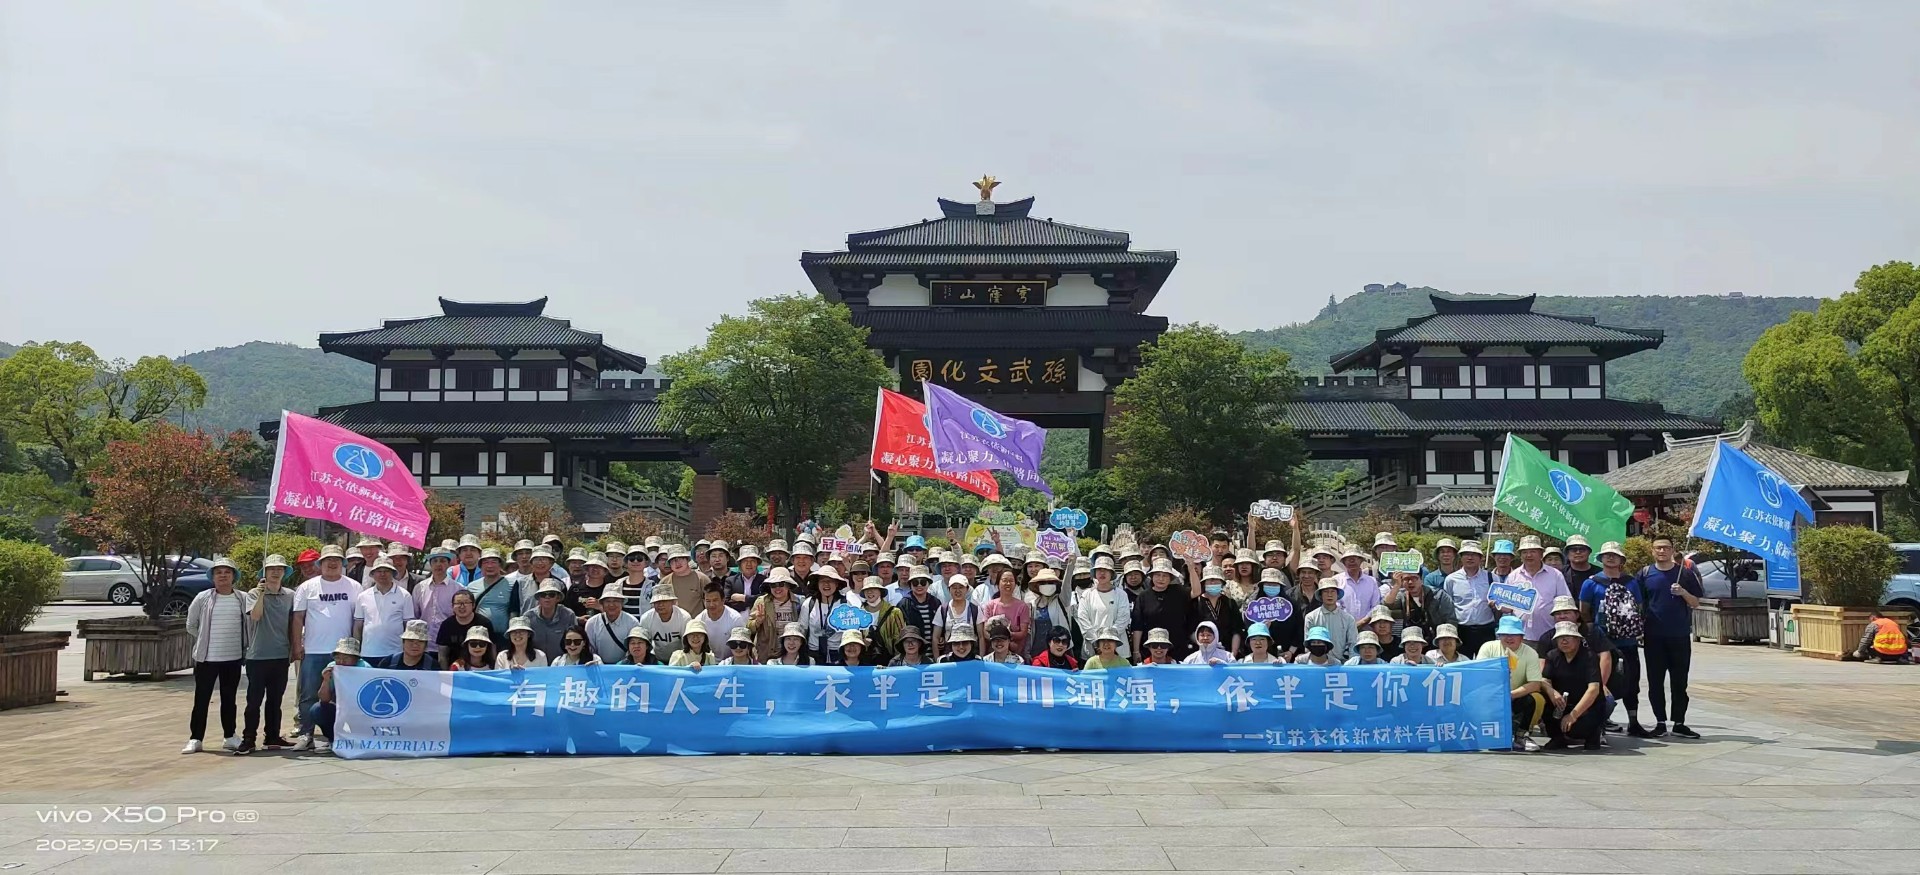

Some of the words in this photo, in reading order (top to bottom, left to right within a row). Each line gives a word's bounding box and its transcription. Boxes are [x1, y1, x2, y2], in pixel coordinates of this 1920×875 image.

[310, 470, 396, 510] 江苏衣依新材料
[1534, 485, 1591, 536] 江苏衣依新材料
[823, 538, 863, 554] 冠军团队
[319, 593, 349, 602] WANG
[838, 609, 856, 619] 未来
[842, 617, 861, 626] 可期
[359, 740, 446, 751] MATERIALS
